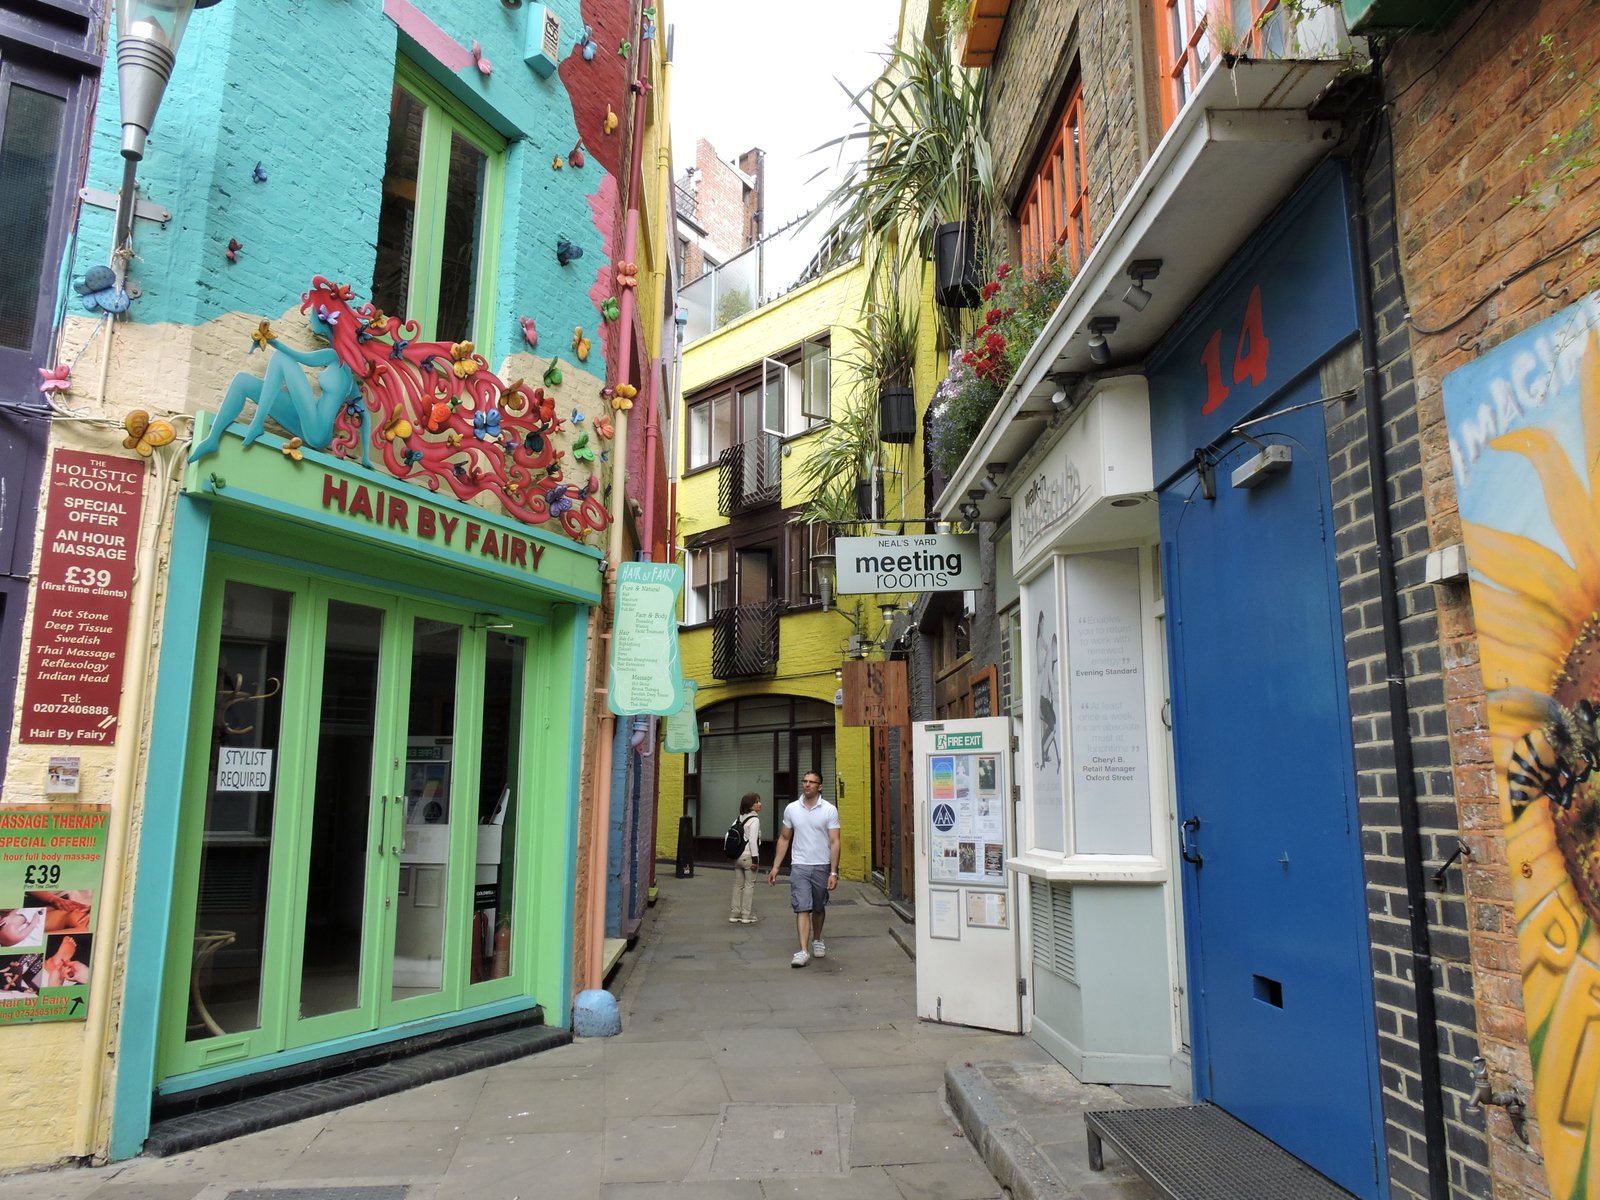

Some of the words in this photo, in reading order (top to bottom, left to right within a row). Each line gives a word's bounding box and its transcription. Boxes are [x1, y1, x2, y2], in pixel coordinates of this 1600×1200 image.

[1200, 284, 1269, 416] 14
[1449, 290, 1600, 487] IMAGIN
[90, 459, 107, 467] THE
[56, 464, 137, 483] HOLISTIC
[69, 478, 121, 493] ROOM
[64, 497, 127, 514] SPECIAL
[69, 511, 118, 526] OFFER
[322, 474, 408, 529] HAIR
[417, 505, 459, 545] BY
[465, 521, 546, 570] FAIRY
[56, 529, 78, 541] AN
[82, 532, 124, 547] HOUR
[53, 542, 127, 560] MASSAGE
[856, 550, 961, 576] meeting
[65, 566, 111, 587] £39
[622, 564, 641, 581] HAIR
[651, 567, 676, 582] FAIRY
[876, 572, 947, 588] rooms
[41, 581, 65, 591] (first
[68, 584, 89, 593] time
[92, 587, 127, 599] clients)
[52, 609, 73, 618] Hot
[76, 610, 109, 620] Stone
[45, 621, 74, 633] Deep
[78, 623, 113, 633] Tissue
[55, 634, 100, 645] Swedish
[36, 645, 63, 655] Thai
[66, 648, 116, 660] Massage
[41, 659, 108, 672] Reflexology
[1076, 669, 1103, 677] Evening
[37, 671, 76, 681] Indian
[79, 674, 110, 683] Head
[632, 674, 653, 682] Massage
[61, 693, 81, 703] Tel:
[33, 704, 109, 715] 02072406888
[30, 729, 55, 738] Hair
[58, 729, 74, 740] By
[77, 730, 106, 741] Fairy
[948, 737, 963, 746] FIRE
[965, 736, 981, 746] EXIT
[226, 750, 267, 766] STYLIST
[1092, 756, 1116, 764] Cheryl
[220, 771, 267, 789] REQUIRED
[878, 726, 888, 866] OMESLICE
[0, 815, 48, 829] ASSAGE
[52, 815, 106, 829] THERAPY
[0, 837, 46, 848] SPECIAL
[50, 837, 96, 847] OFFER!!!
[3, 852, 23, 861] hour
[25, 852, 39, 861] full
[41, 852, 62, 862] body
[24, 864, 61, 884] £39
[25, 998, 38, 1008] by
[42, 995, 70, 1006] Fairy
